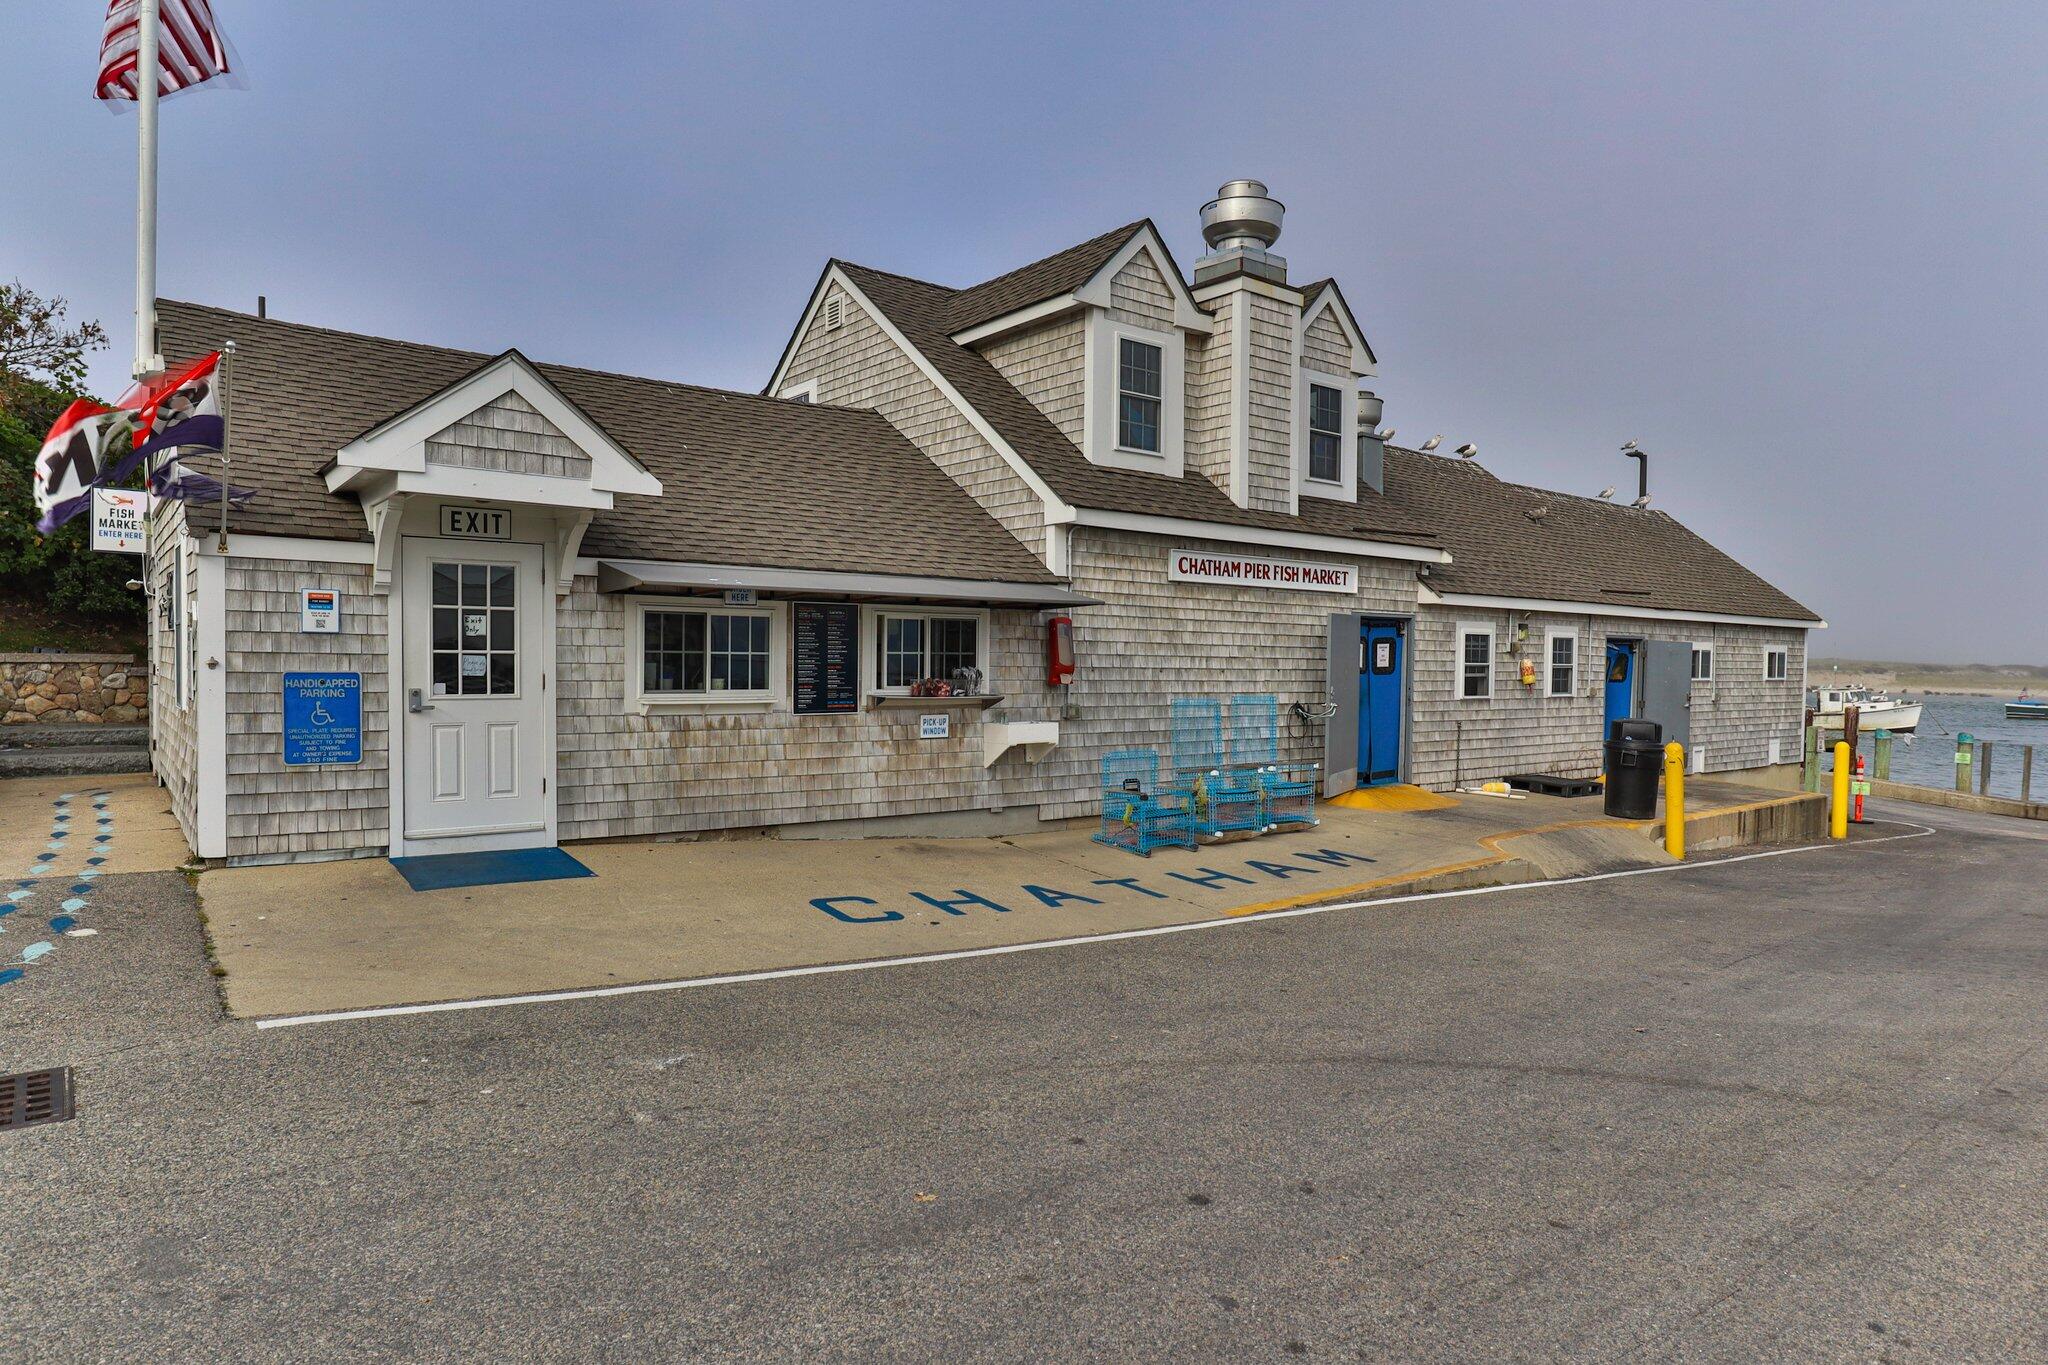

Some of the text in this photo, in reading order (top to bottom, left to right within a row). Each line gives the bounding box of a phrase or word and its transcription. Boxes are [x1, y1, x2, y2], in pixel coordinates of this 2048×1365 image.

[109, 508, 135, 519] FISH
[451, 510, 503, 534] EXIT
[98, 530, 144, 540] ENTER HERE
[1178, 556, 1349, 586] CHATHAM PIER FISH MARKET
[731, 593, 750, 602] HERE
[464, 616, 482, 624] Exit
[464, 625, 480, 635] Only
[285, 679, 359, 688] HANDICAPPED
[300, 688, 346, 698] PARKING
[922, 718, 947, 727] PICK-UP
[922, 727, 947, 735] WINDOW
[810, 848, 1378, 924] CHATHAM
